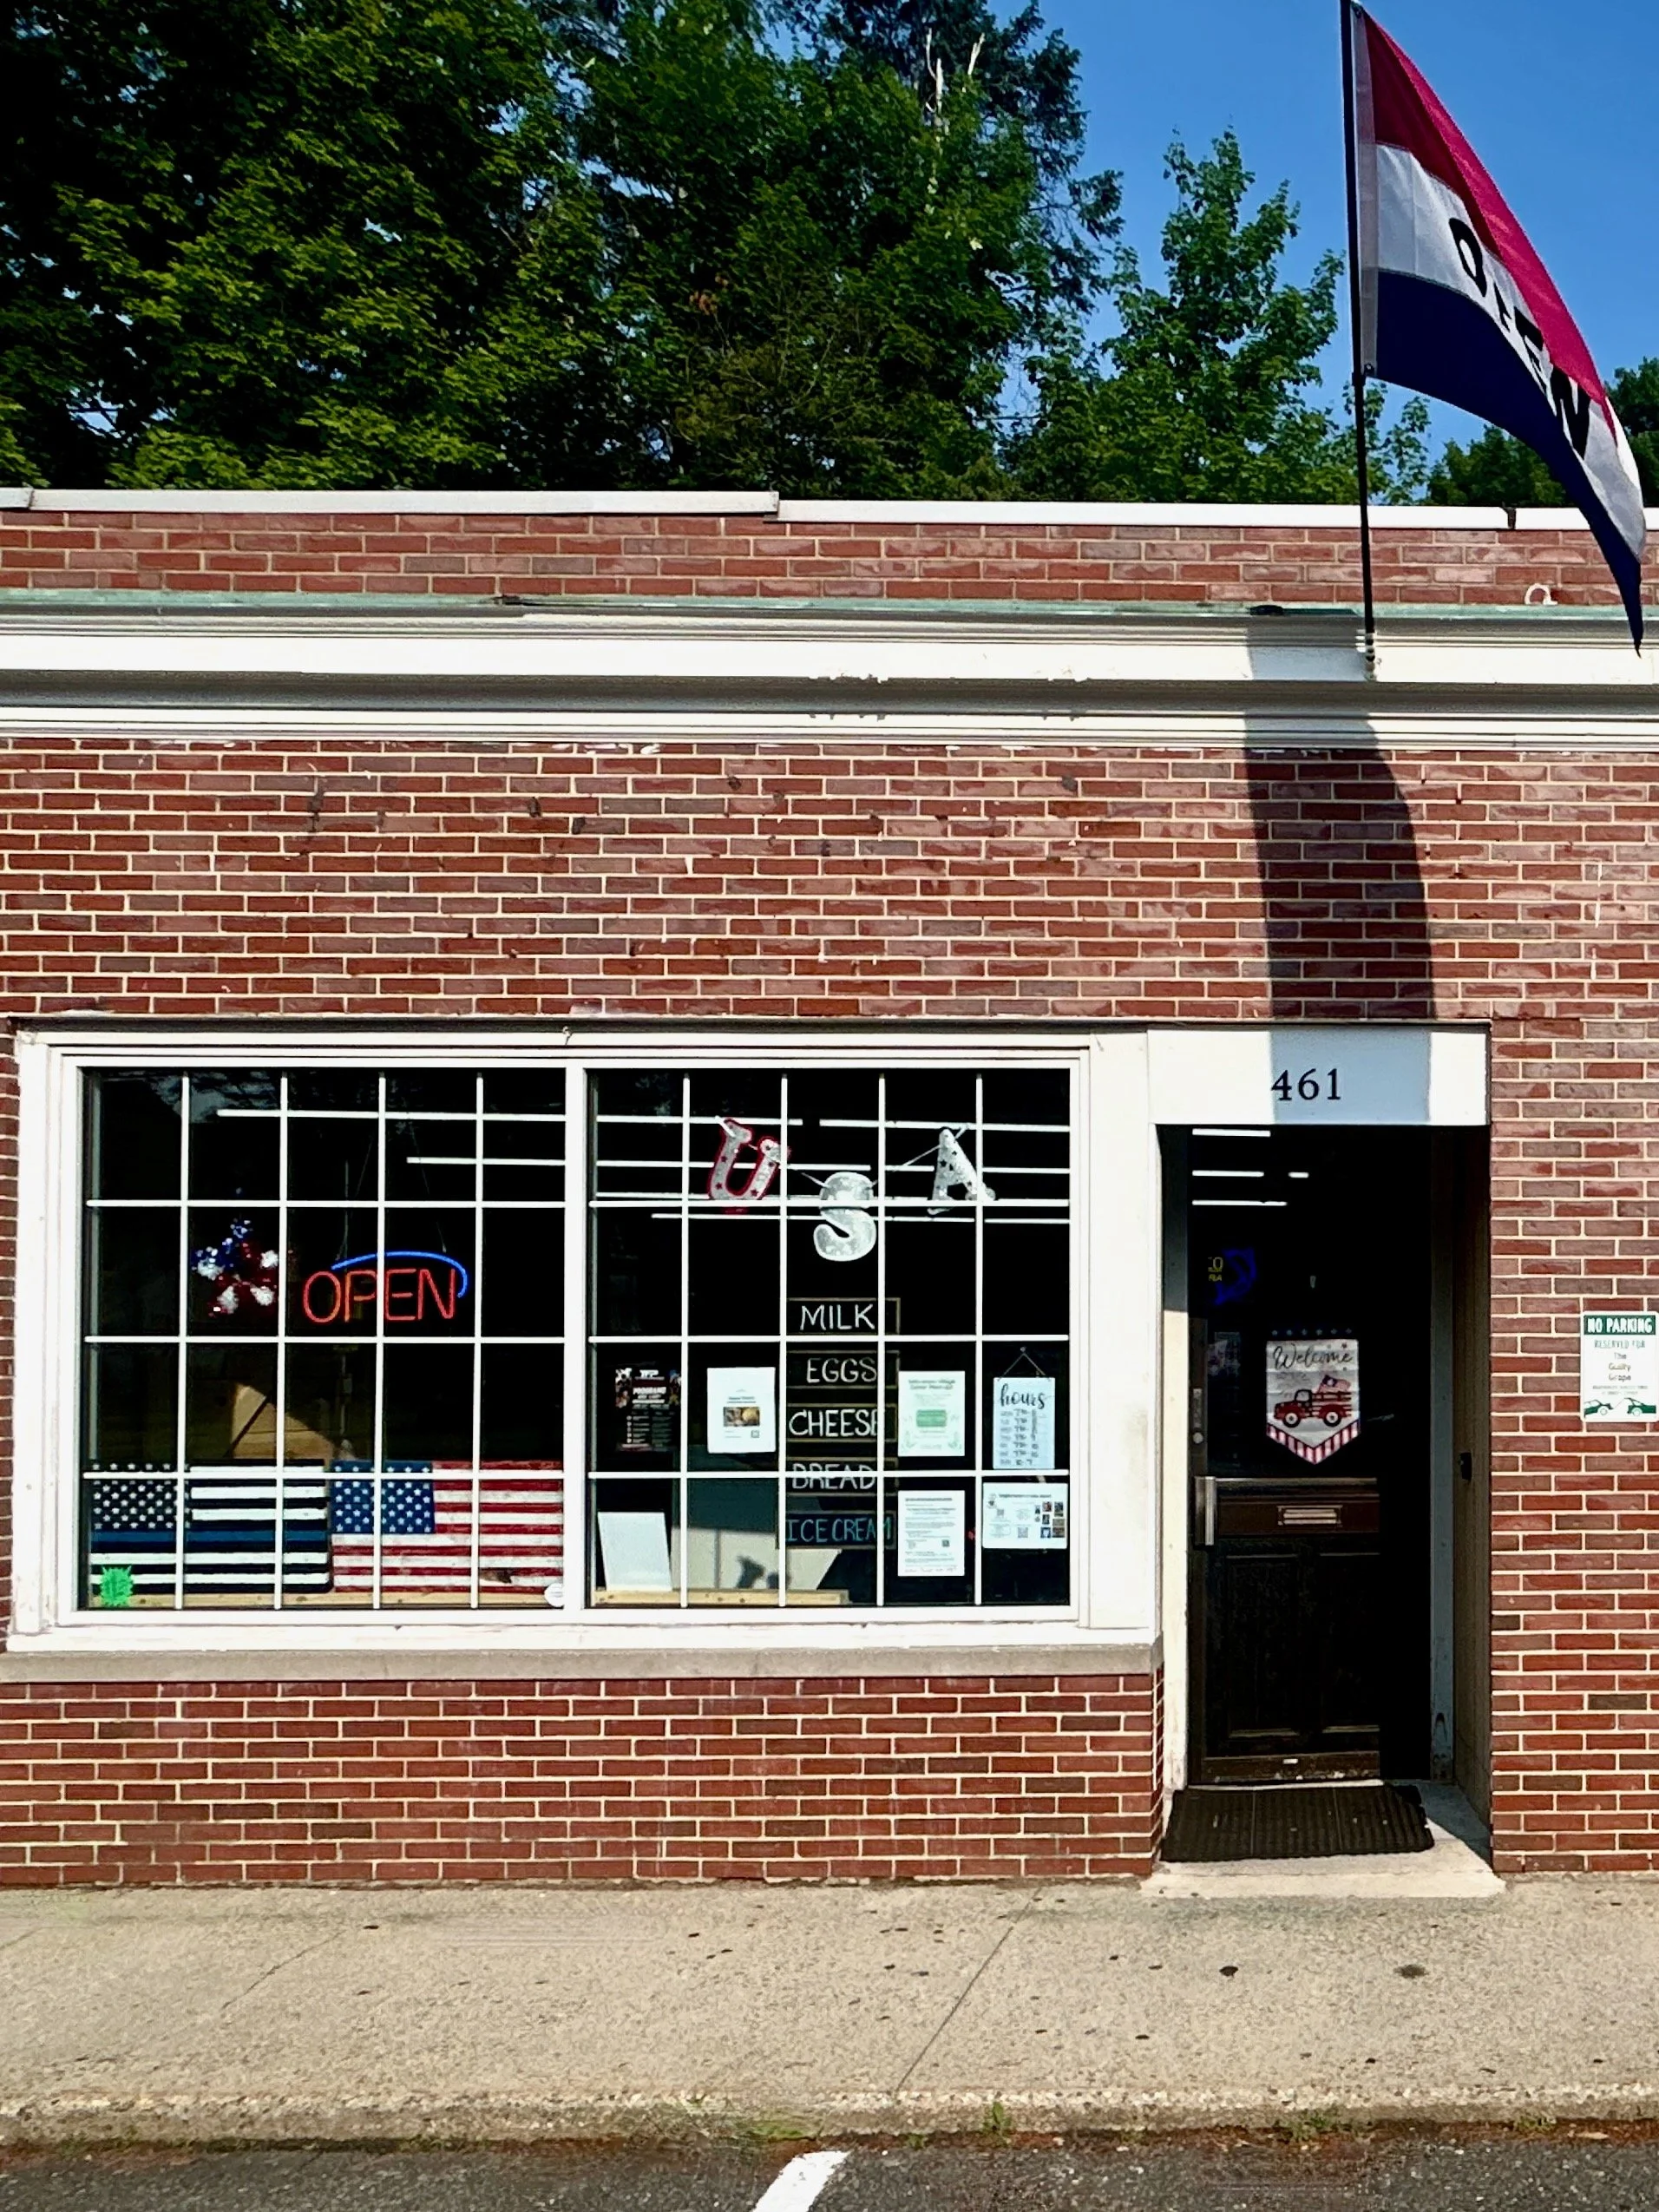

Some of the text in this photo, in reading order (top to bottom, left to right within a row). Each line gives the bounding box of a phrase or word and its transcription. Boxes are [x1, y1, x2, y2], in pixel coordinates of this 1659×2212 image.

[1271, 1067, 1341, 1100] 461
[709, 1118, 996, 1262] USA
[304, 1268, 457, 1325] OPEN
[800, 1303, 875, 1330] MILK
[1587, 1317, 1653, 1334] NO PARKING
[1273, 1343, 1354, 1370] Welcome
[1594, 1339, 1629, 1349] RESERVED
[806, 1356, 877, 1383] EGGS
[1000, 1382, 1046, 1410] hours
[791, 1462, 876, 1490] BREAD
[785, 1519, 829, 1542] ICE
